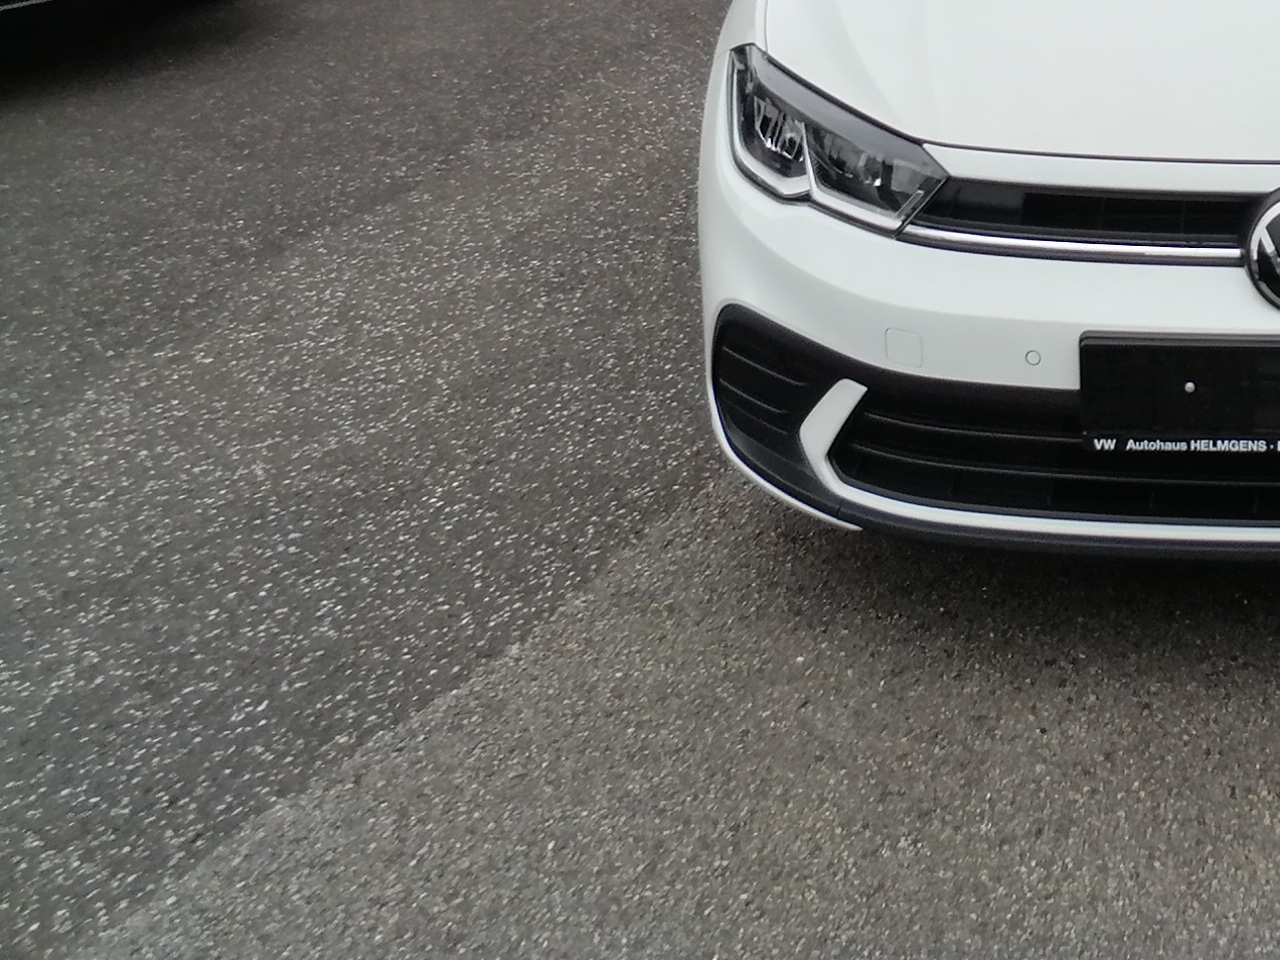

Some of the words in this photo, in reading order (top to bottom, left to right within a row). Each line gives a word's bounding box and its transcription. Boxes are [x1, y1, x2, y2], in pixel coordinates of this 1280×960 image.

[1093, 438, 1117, 451] VW
[1126, 438, 1188, 452] Autohaus
[1190, 440, 1267, 452] HELMGENS
